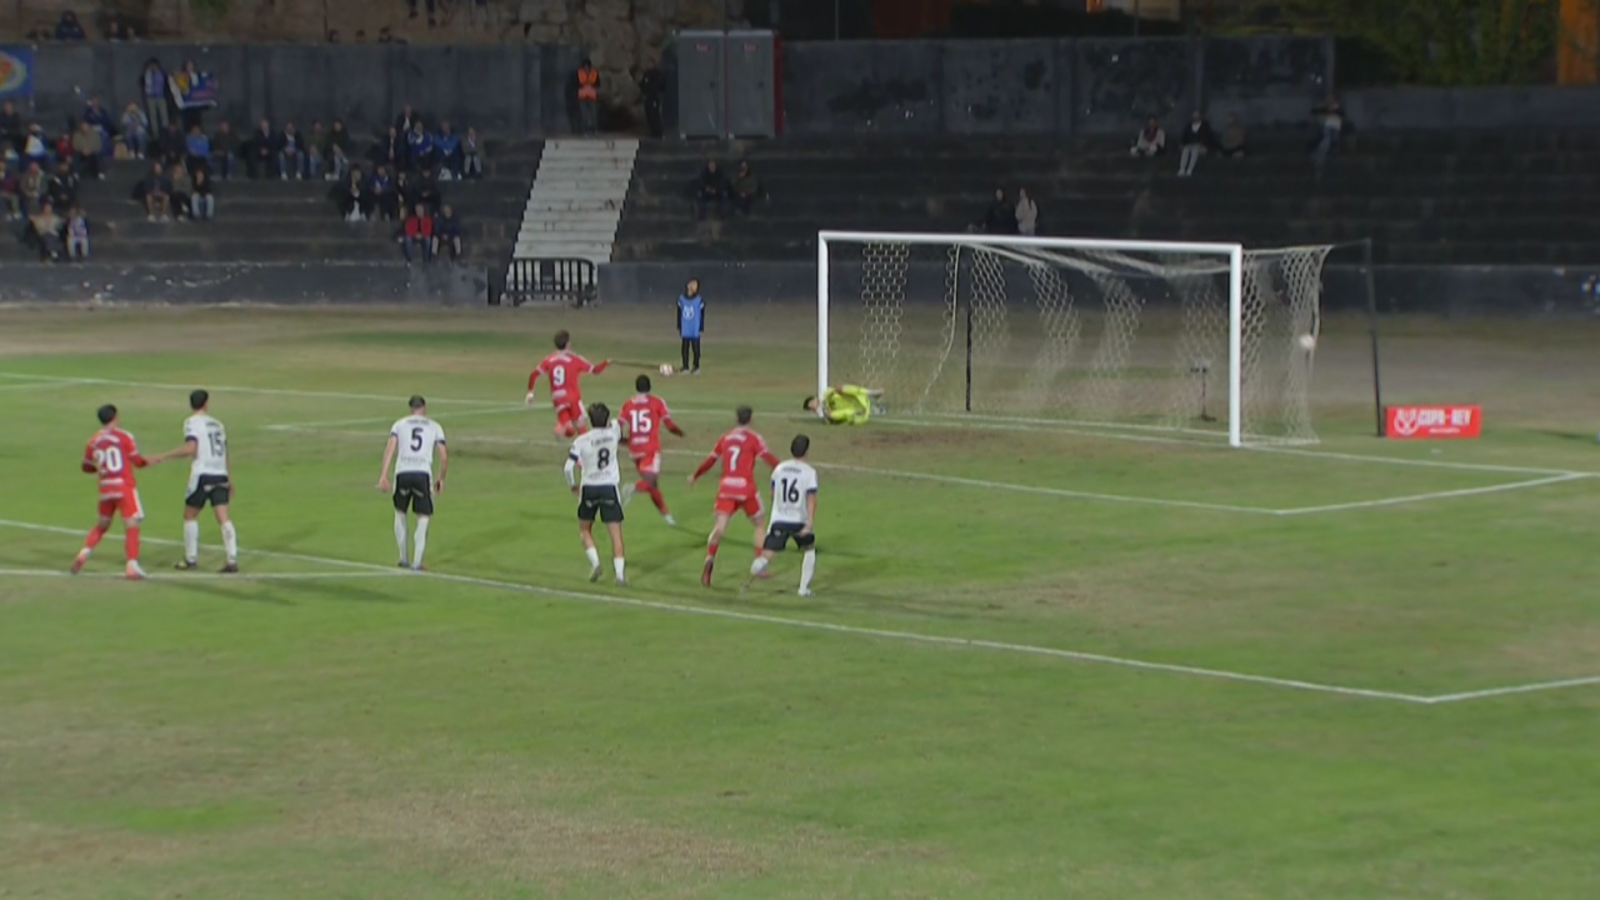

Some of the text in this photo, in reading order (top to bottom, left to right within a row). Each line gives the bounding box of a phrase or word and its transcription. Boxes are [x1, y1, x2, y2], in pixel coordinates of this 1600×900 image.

[553, 365, 565, 387] 9
[629, 409, 652, 434] 15
[208, 432, 224, 457] 15
[410, 427, 424, 452] 5
[93, 446, 123, 473] 20
[598, 448, 610, 470] 8
[728, 445, 741, 472] 7
[781, 478, 800, 503] 16
